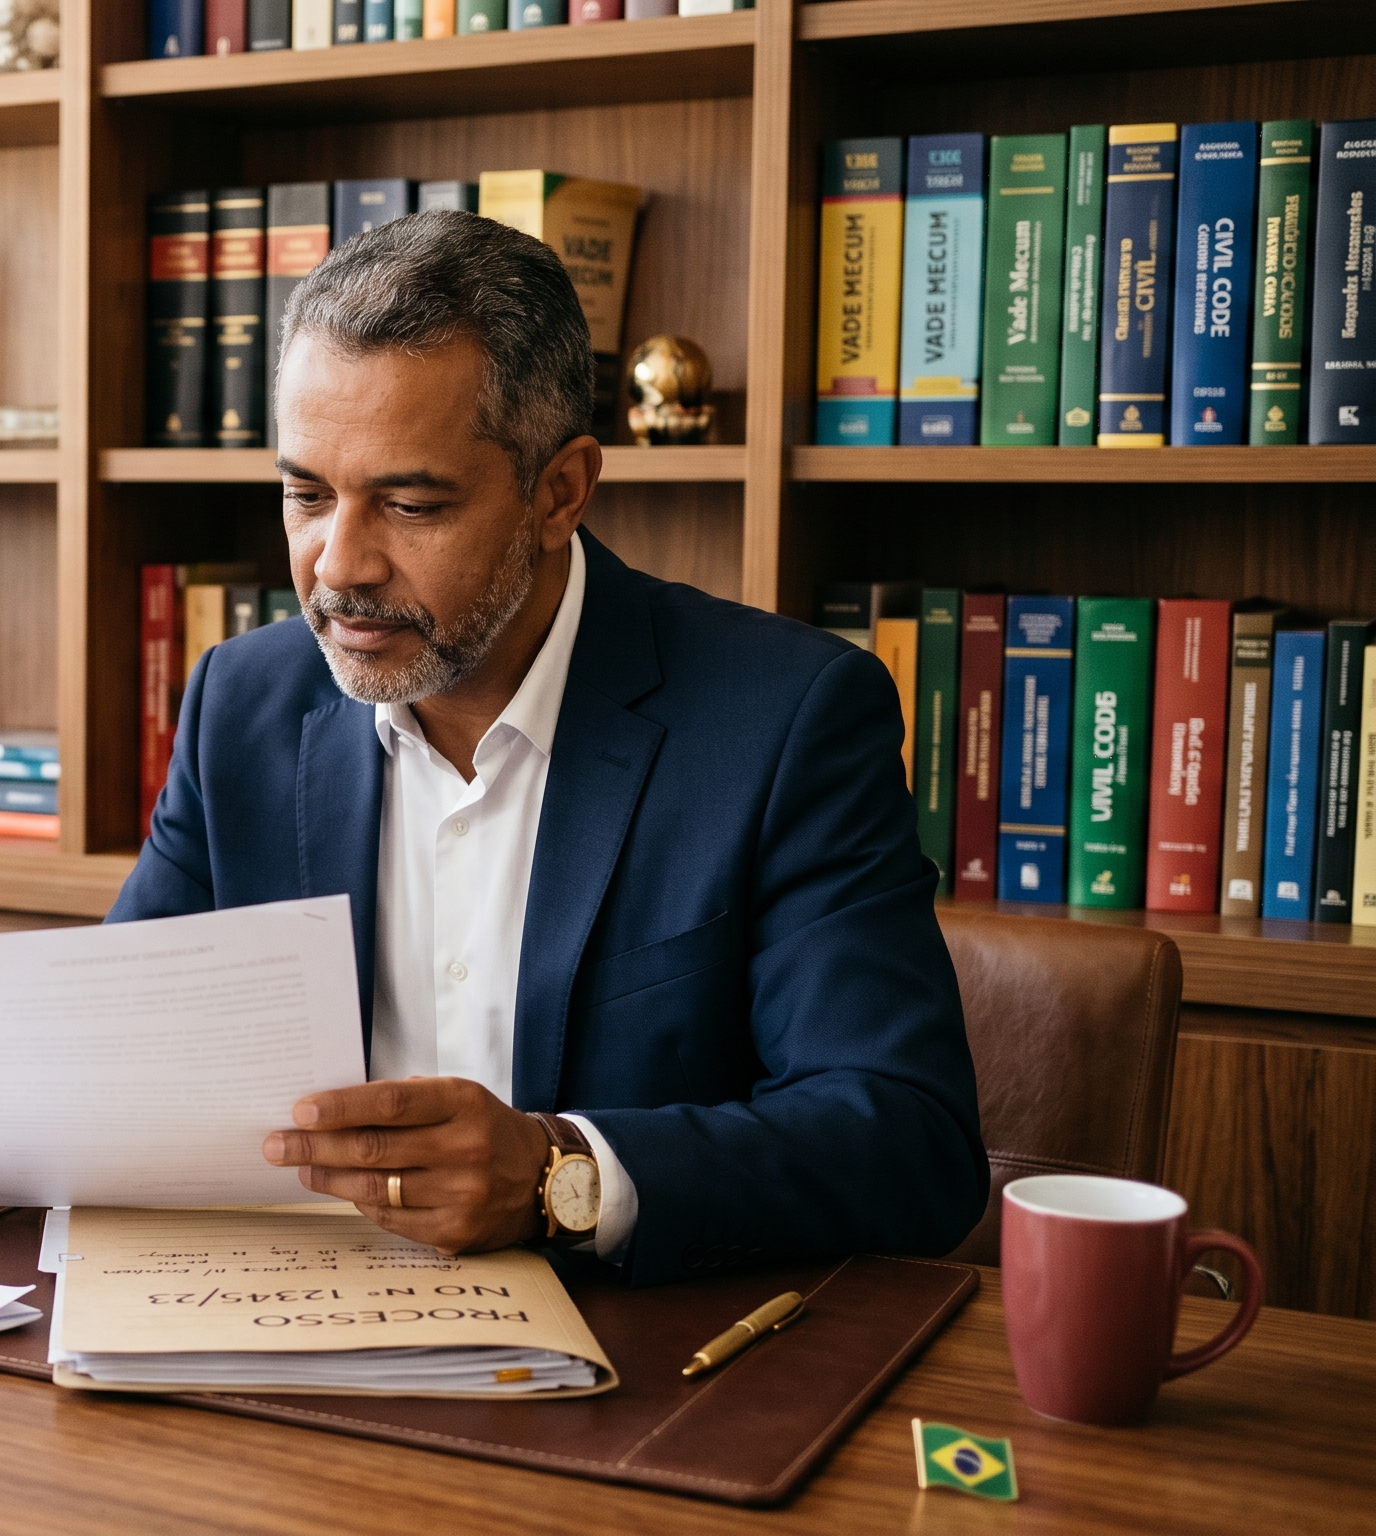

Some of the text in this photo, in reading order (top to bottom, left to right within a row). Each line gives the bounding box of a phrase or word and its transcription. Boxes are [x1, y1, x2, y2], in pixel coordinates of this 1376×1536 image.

[843, 213, 865, 296] MECUM
[927, 211, 948, 295] MECUM
[1008, 220, 1031, 292] Mecum
[1134, 252, 1157, 312] CIVIL
[1210, 217, 1235, 338] CIVIL CODE
[841, 303, 863, 365] VADE
[924, 303, 946, 364] VADE
[1006, 296, 1028, 346] Vade
[148, 1288, 344, 1307] 12345/23
[253, 1307, 530, 1328] PROCESSO
[434, 1285, 511, 1298] NO
